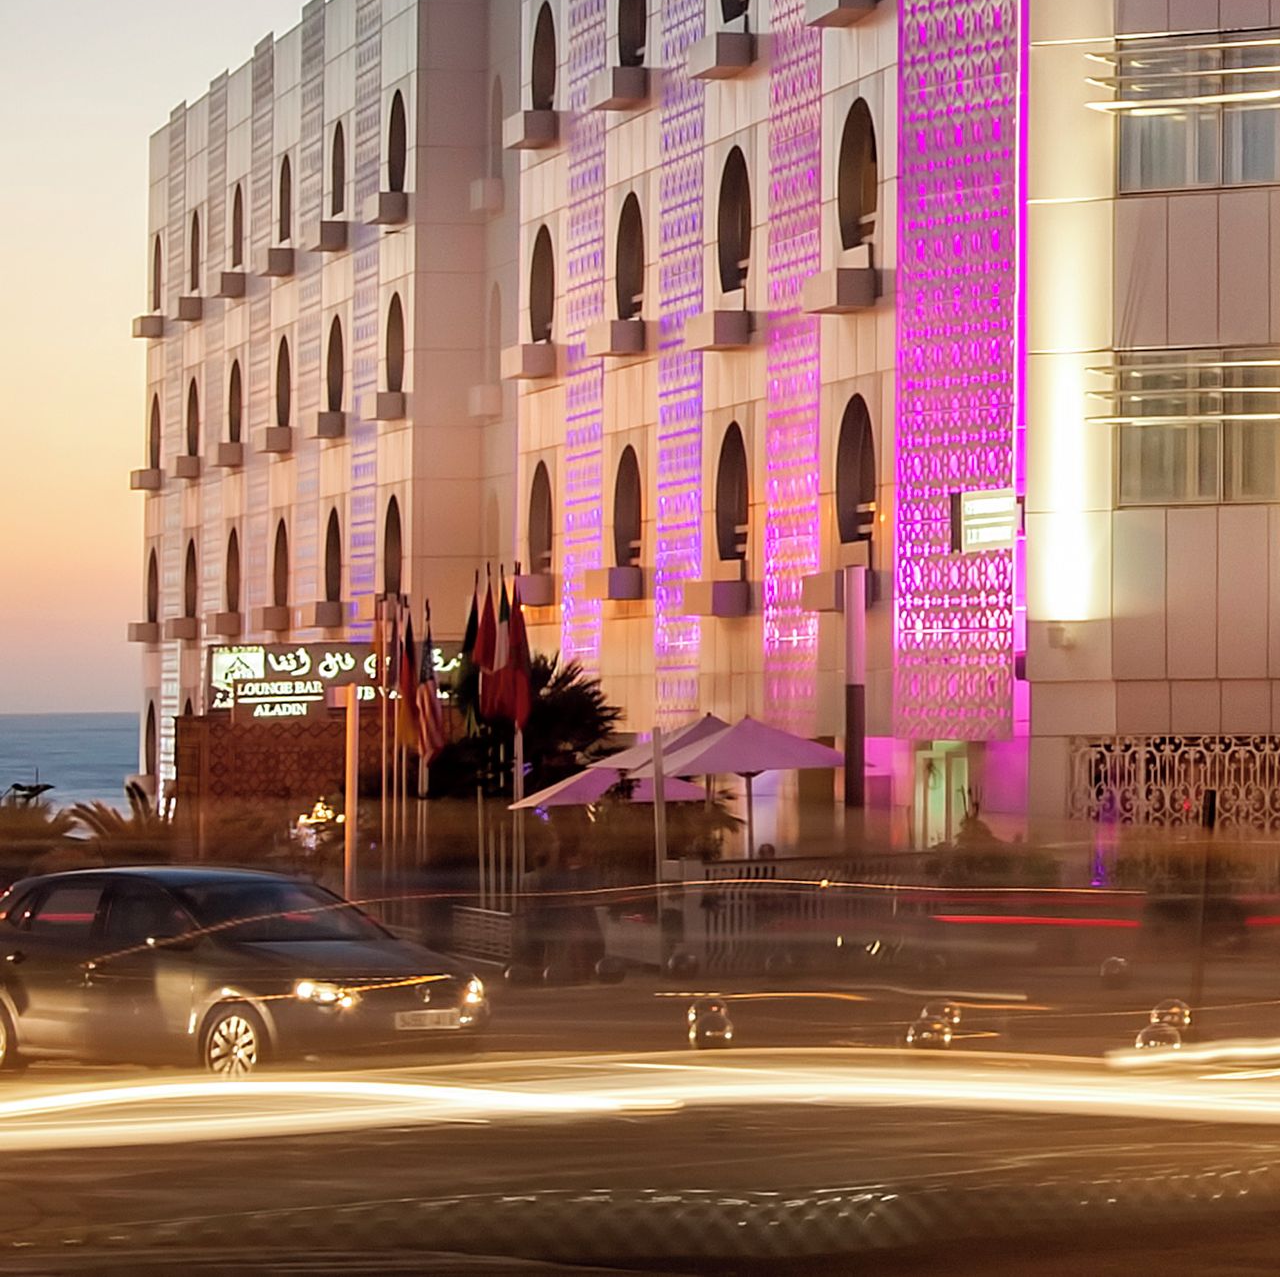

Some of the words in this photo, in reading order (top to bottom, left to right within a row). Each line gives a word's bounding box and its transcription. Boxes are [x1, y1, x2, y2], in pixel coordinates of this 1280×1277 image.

[237, 682, 293, 697] LOUNGE
[294, 680, 324, 694] BAR
[253, 703, 308, 717] ALADIN
